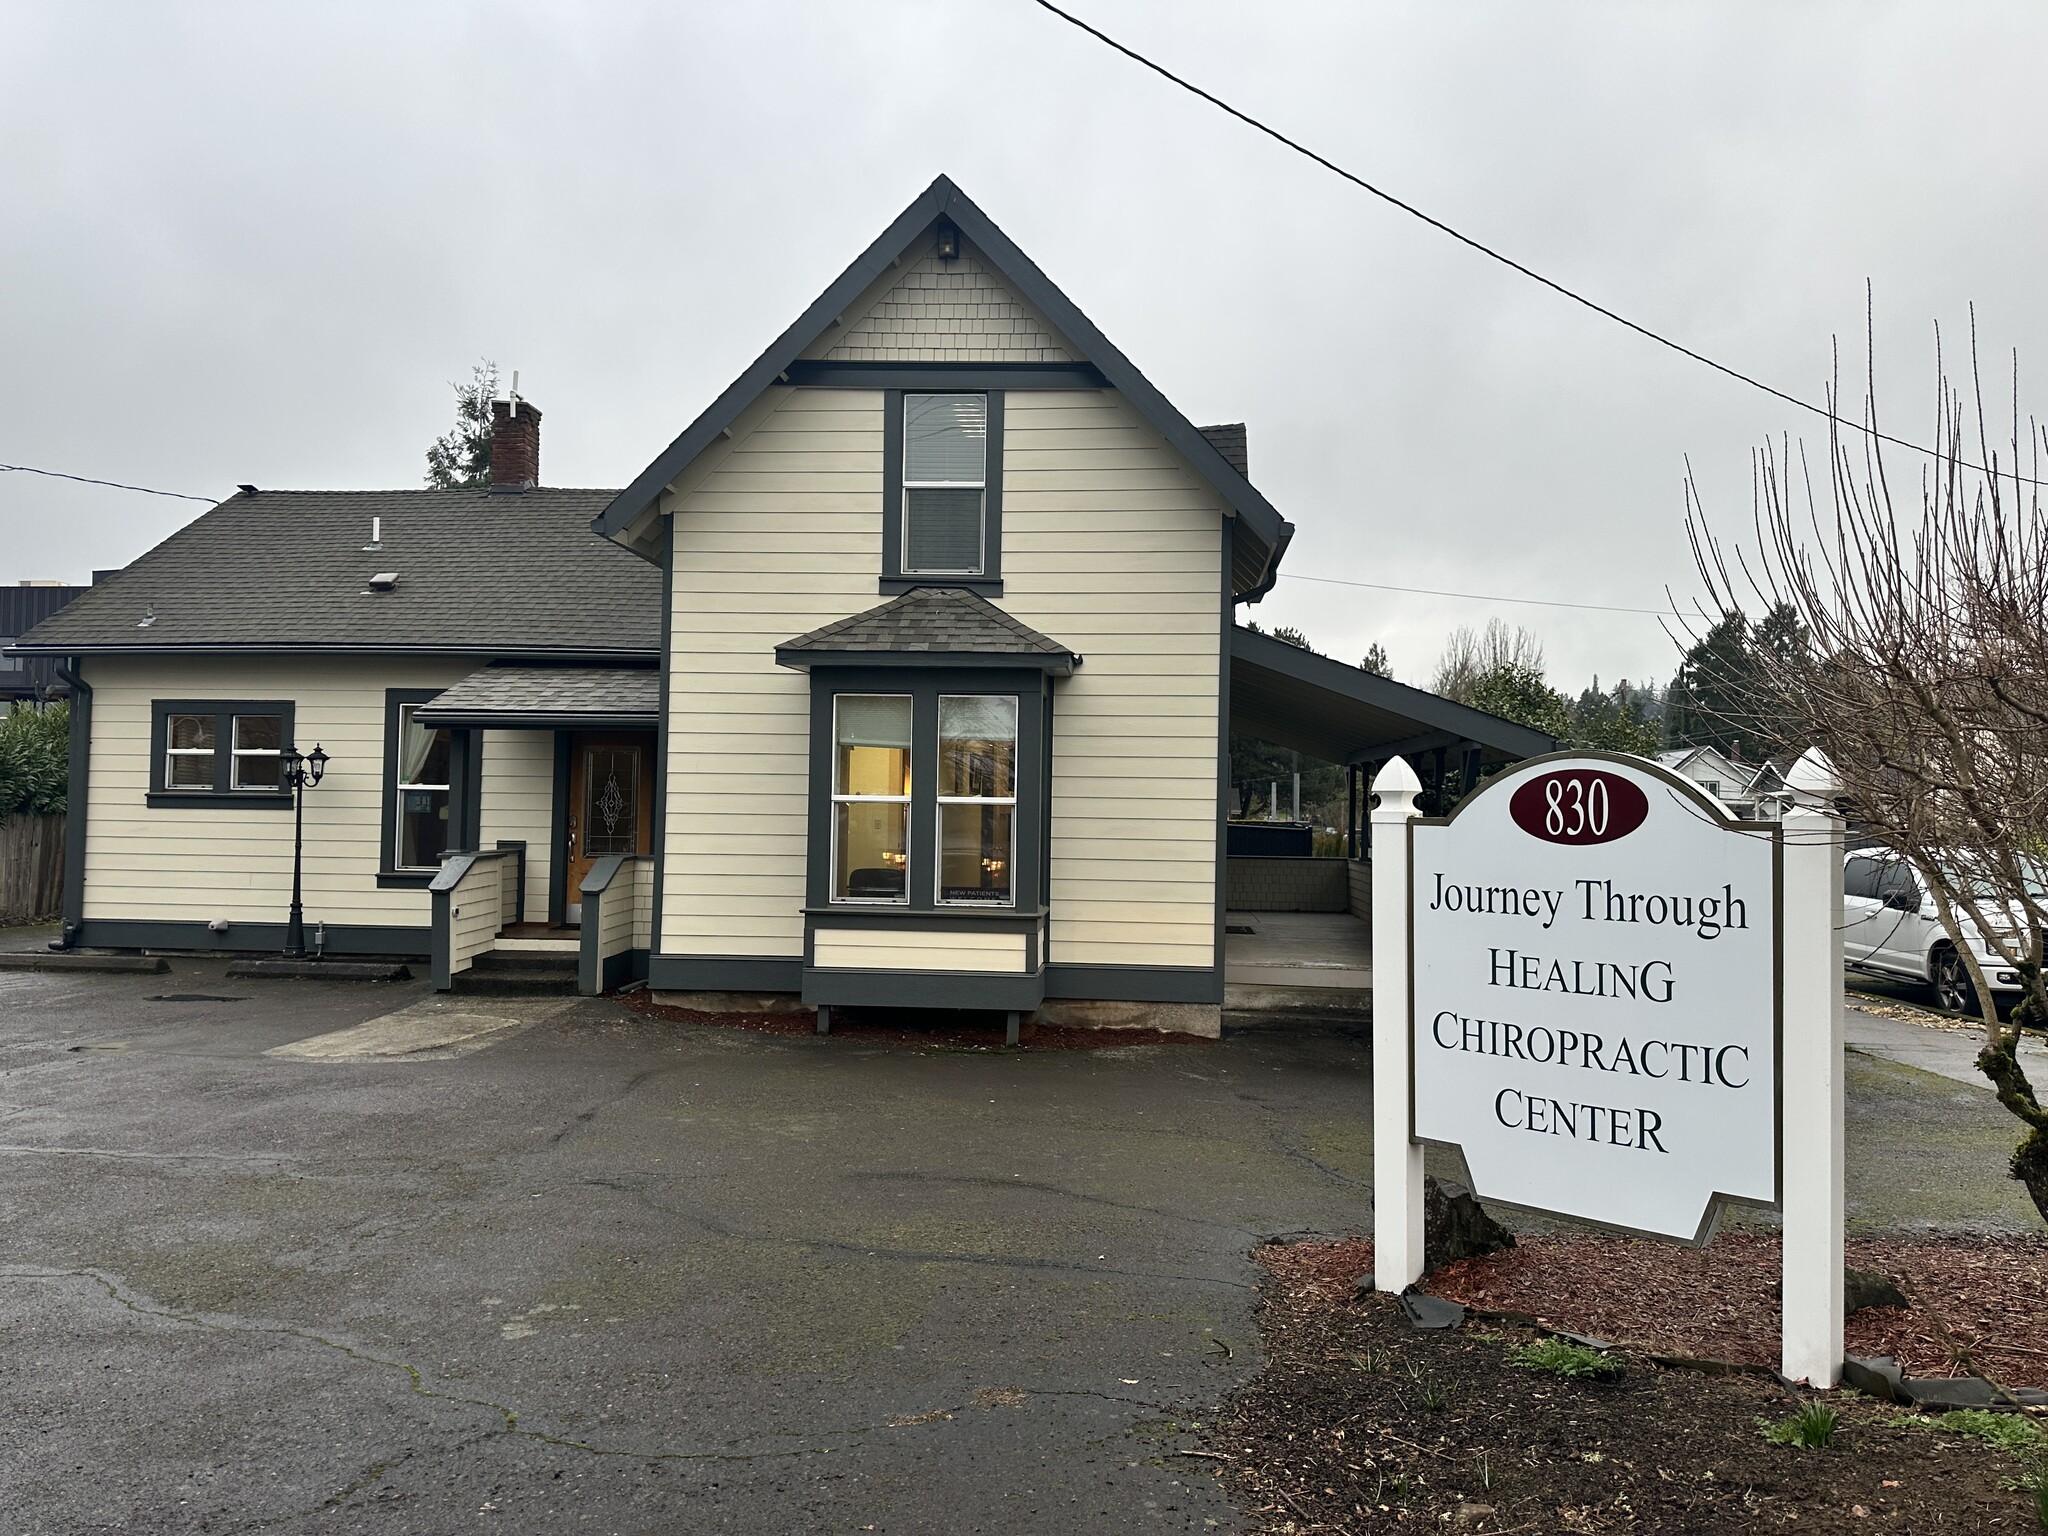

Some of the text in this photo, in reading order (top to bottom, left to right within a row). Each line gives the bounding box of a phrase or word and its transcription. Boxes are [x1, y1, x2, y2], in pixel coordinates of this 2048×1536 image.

[1544, 778, 1609, 837] 830
[1430, 872, 1749, 940] Journey Through
[1487, 947, 1676, 1003] HEALING
[1432, 1011, 1750, 1088] CHIROPRACTIC
[1495, 1088, 1670, 1154] CENTER
